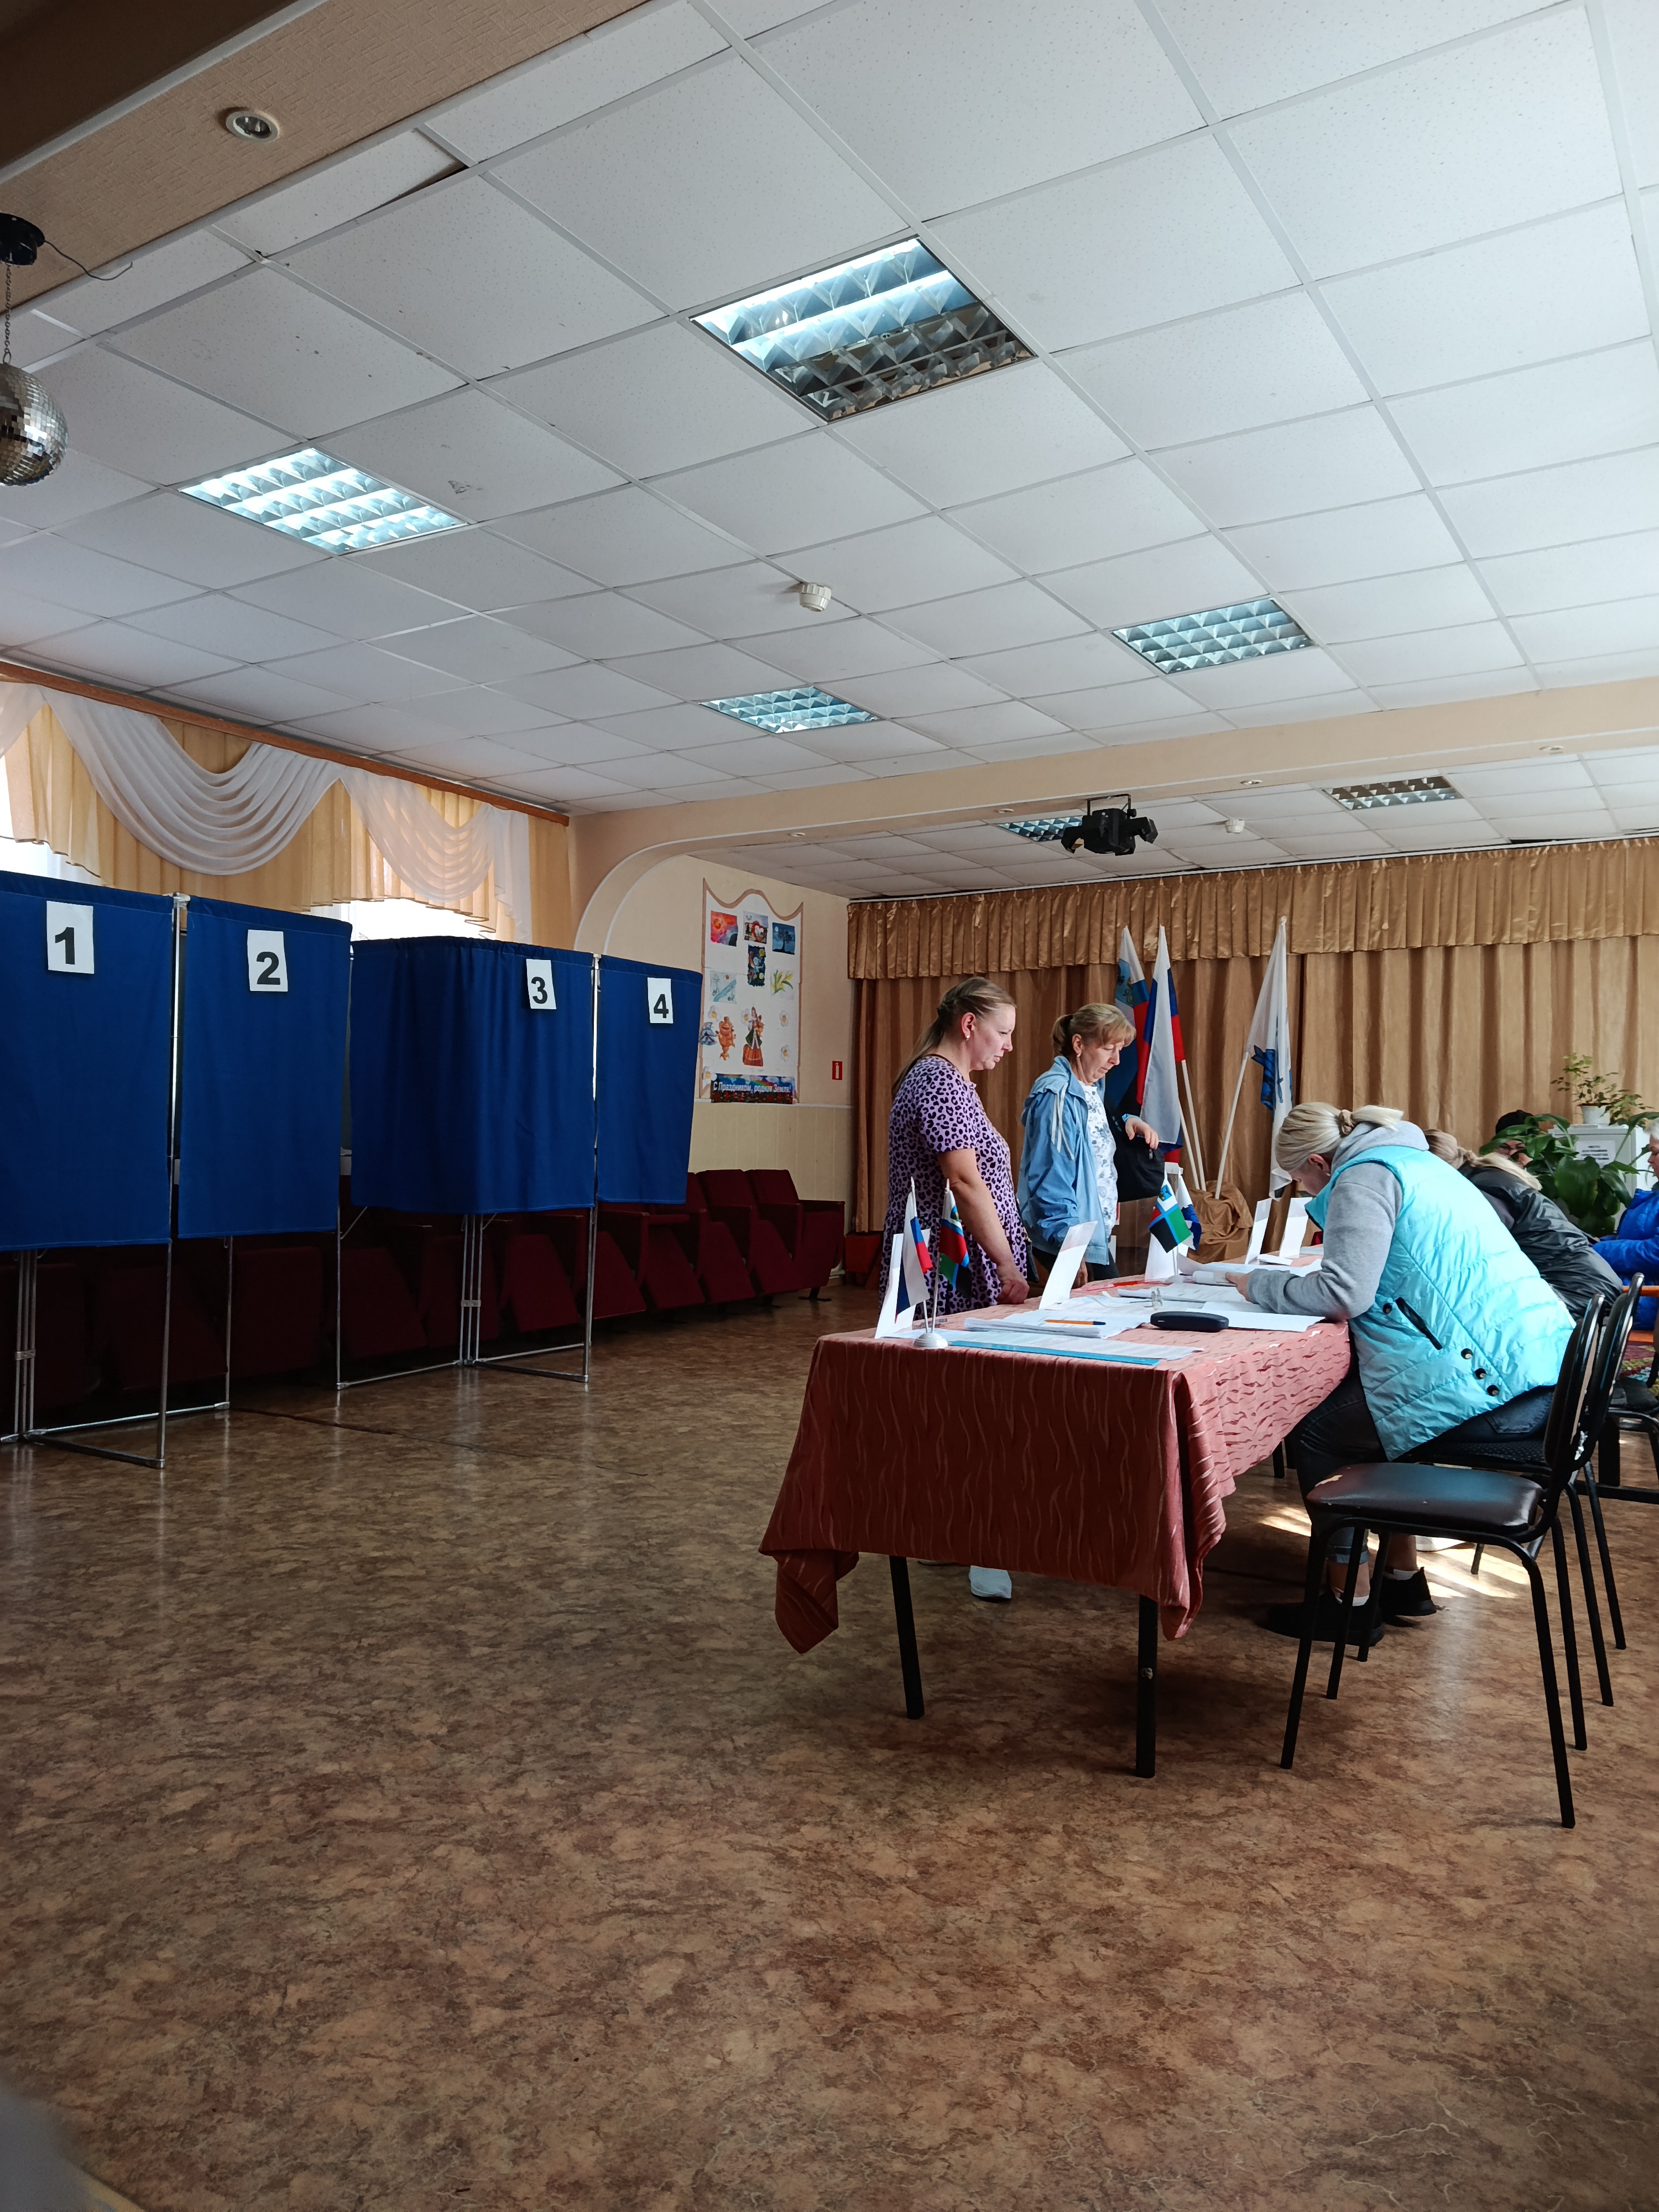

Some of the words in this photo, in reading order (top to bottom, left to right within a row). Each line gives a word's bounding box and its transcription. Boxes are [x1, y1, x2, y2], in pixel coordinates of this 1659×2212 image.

[55, 927, 75, 964] 1
[257, 952, 280, 985] 2
[531, 977, 547, 1004] 3
[654, 994, 669, 1018] 4
[774, 1084, 791, 1093] Земля!
